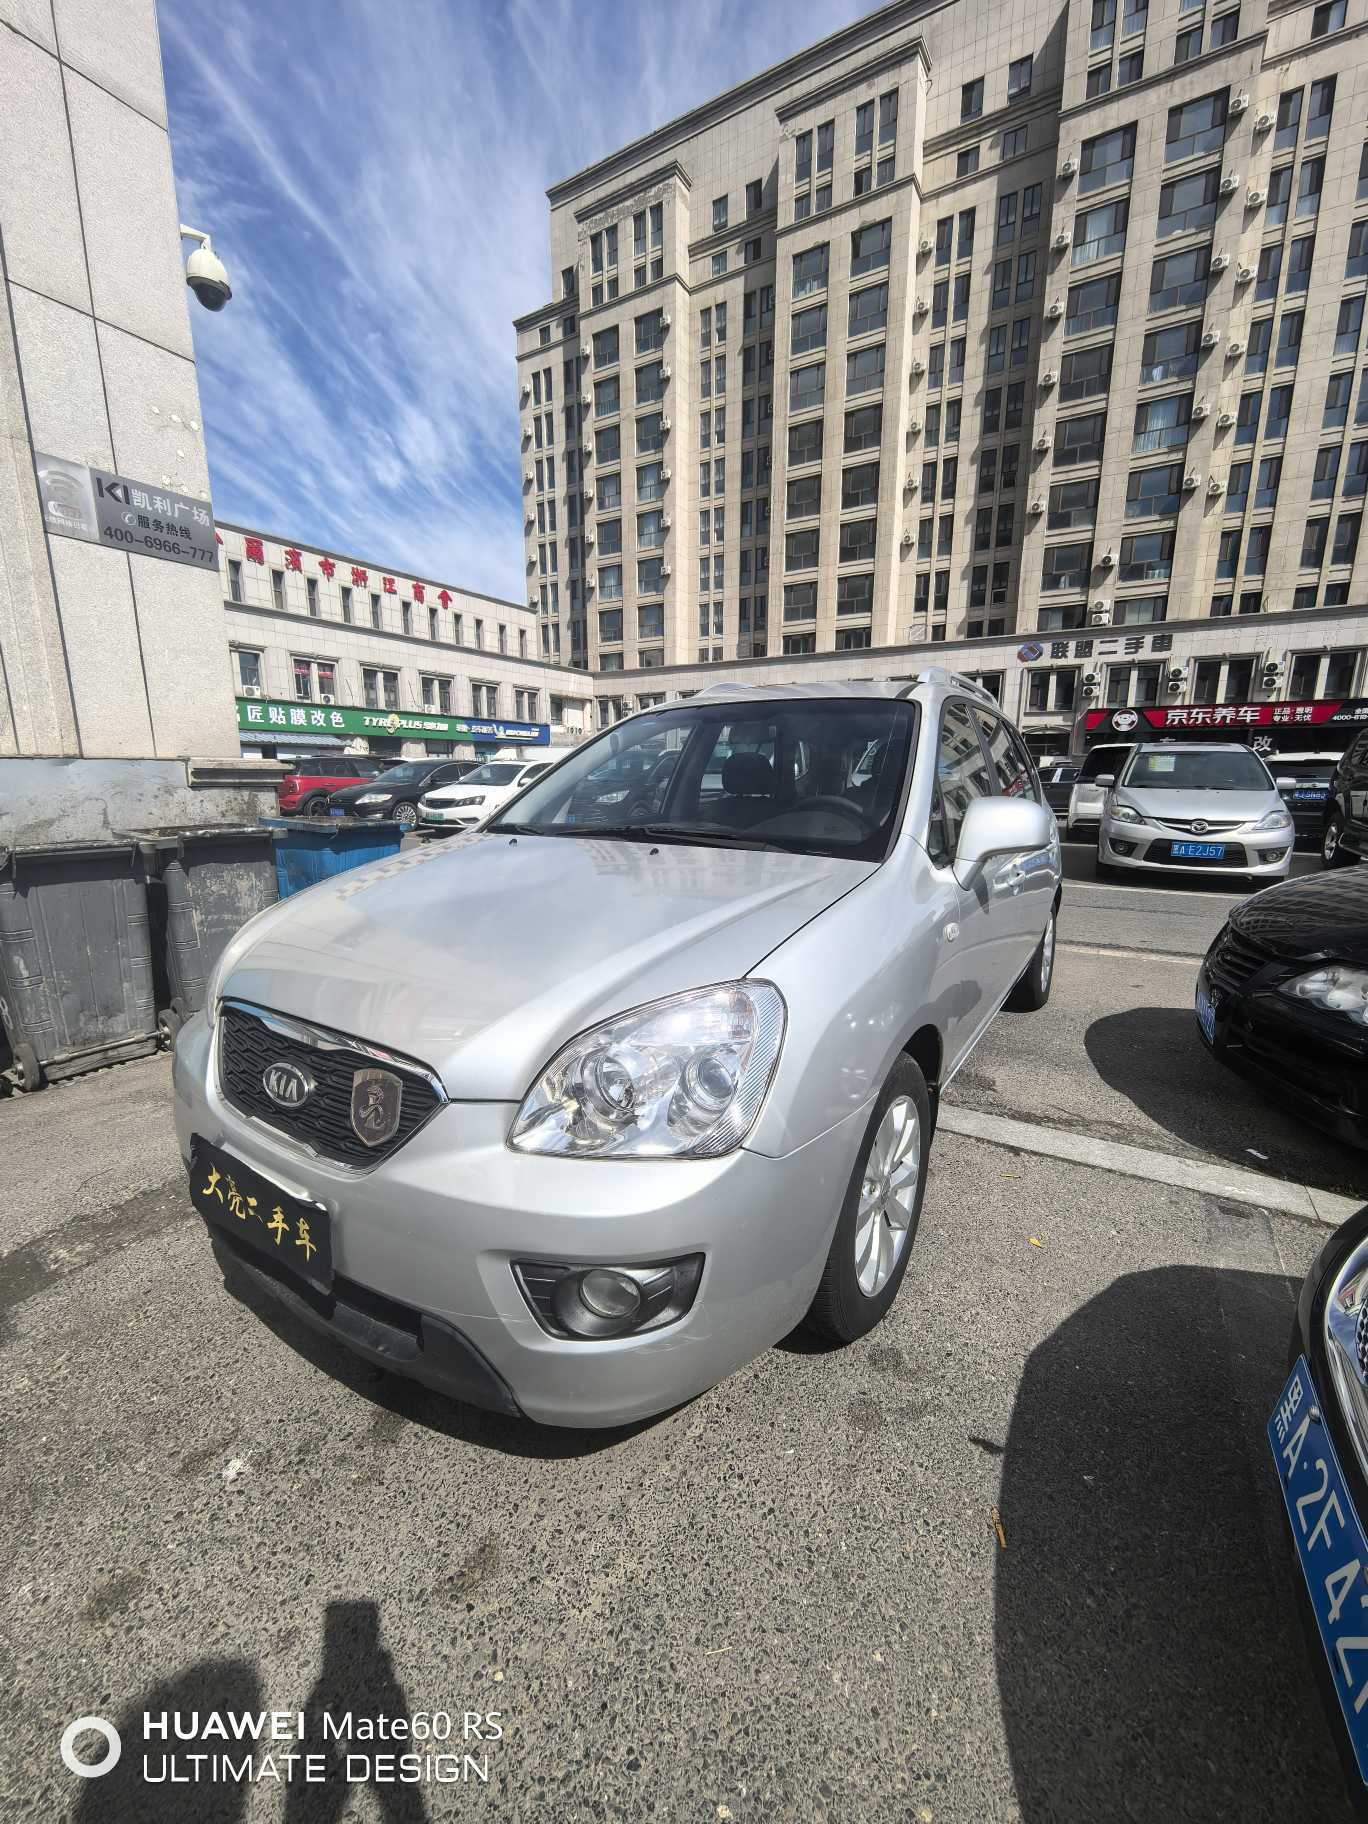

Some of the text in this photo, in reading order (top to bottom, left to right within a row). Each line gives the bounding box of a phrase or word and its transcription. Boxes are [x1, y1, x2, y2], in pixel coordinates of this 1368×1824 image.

[131, 488, 210, 527] 凯利广场
[138, 514, 192, 541] 服务热线
[103, 526, 214, 563] 400-6966-777
[1165, 706, 1261, 725] 京东养车
[1252, 736, 1273, 752] 改
[268, 1069, 299, 1102] KIA
[202, 1162, 317, 1262] 大亮二手车
